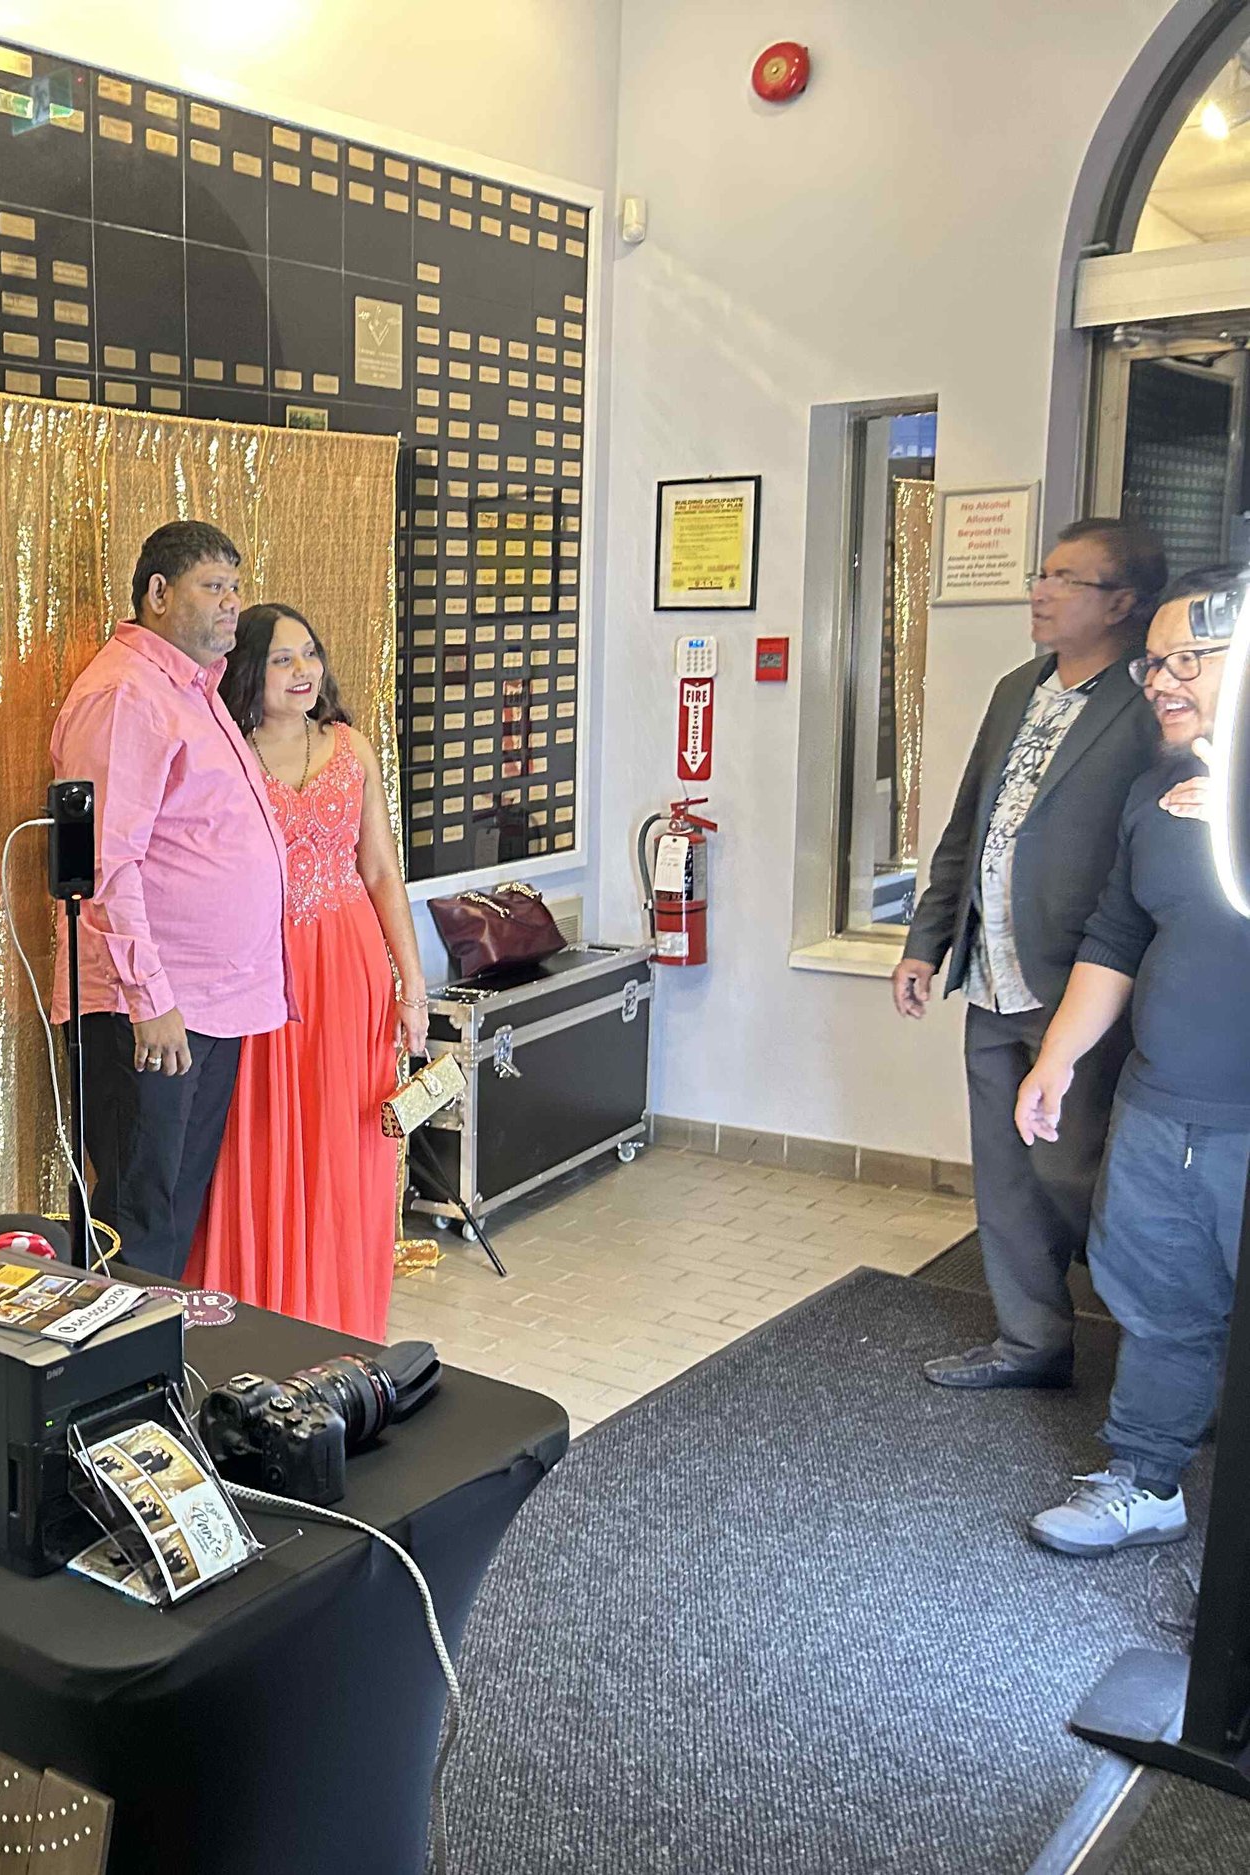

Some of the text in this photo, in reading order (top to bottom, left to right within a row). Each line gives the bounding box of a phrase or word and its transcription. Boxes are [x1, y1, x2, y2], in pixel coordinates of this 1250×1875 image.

[961, 499, 1011, 511] No Alcohol
[966, 514, 1003, 524] Allowed
[958, 529, 992, 537] Beyond
[686, 690, 708, 703] FIRE
[690, 705, 700, 765] EXTINGUISHER
